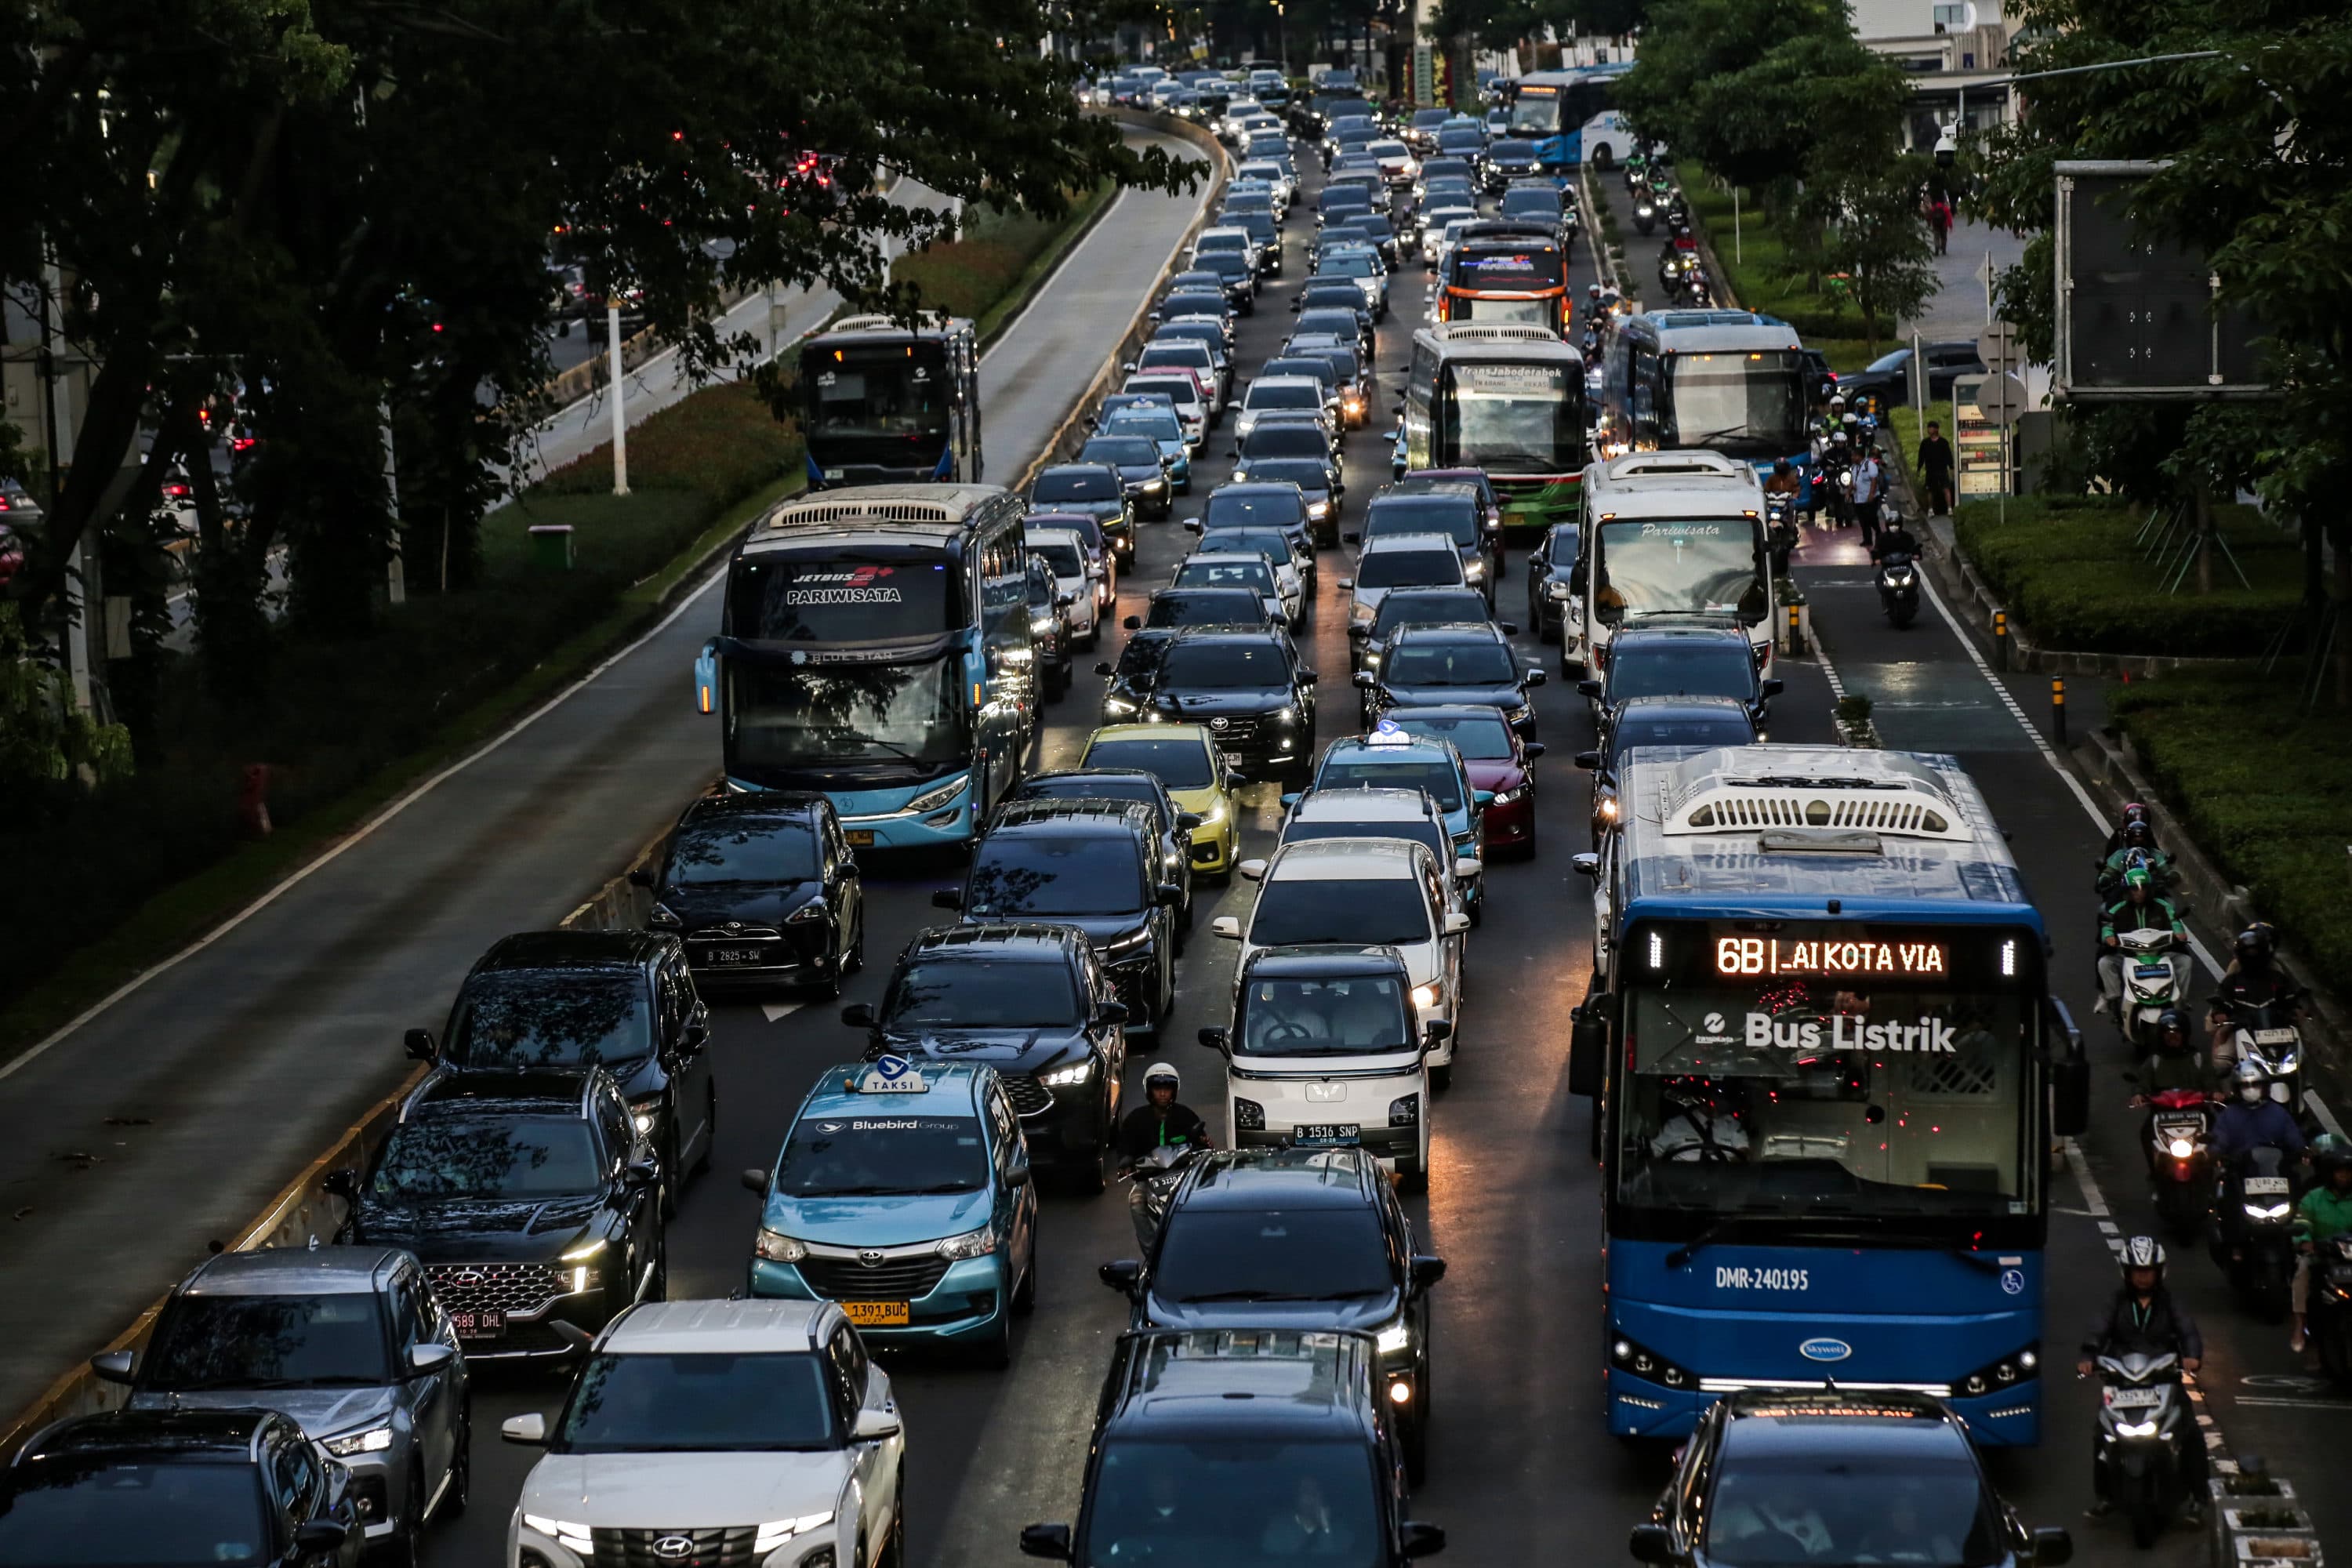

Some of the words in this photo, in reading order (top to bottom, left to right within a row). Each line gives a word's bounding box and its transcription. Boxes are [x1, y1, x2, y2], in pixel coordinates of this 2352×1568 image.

[1642, 523, 1719, 537] Pariwisata
[793, 573, 855, 583] JETBUS
[787, 588, 902, 604] PARIWISATA
[856, 652, 893, 661] STAR
[1718, 938, 1764, 974] 6B
[1824, 942, 1893, 971] KOTA
[1899, 943, 1943, 972] VIA
[1745, 1012, 1821, 1049] Bus
[1832, 1014, 1957, 1053] Listrik
[872, 1081, 914, 1090] TAKSI
[852, 1120, 917, 1130] Bluebird
[919, 1121, 959, 1131] Group
[1297, 1127, 1304, 1138] B
[1308, 1126, 1334, 1138] 1516
[1339, 1125, 1358, 1138] SNP
[1715, 1266, 1809, 1291] DMR-240195
[851, 1305, 882, 1317] 1391
[884, 1304, 906, 1317] BUC
[482, 1314, 501, 1327] DHL
